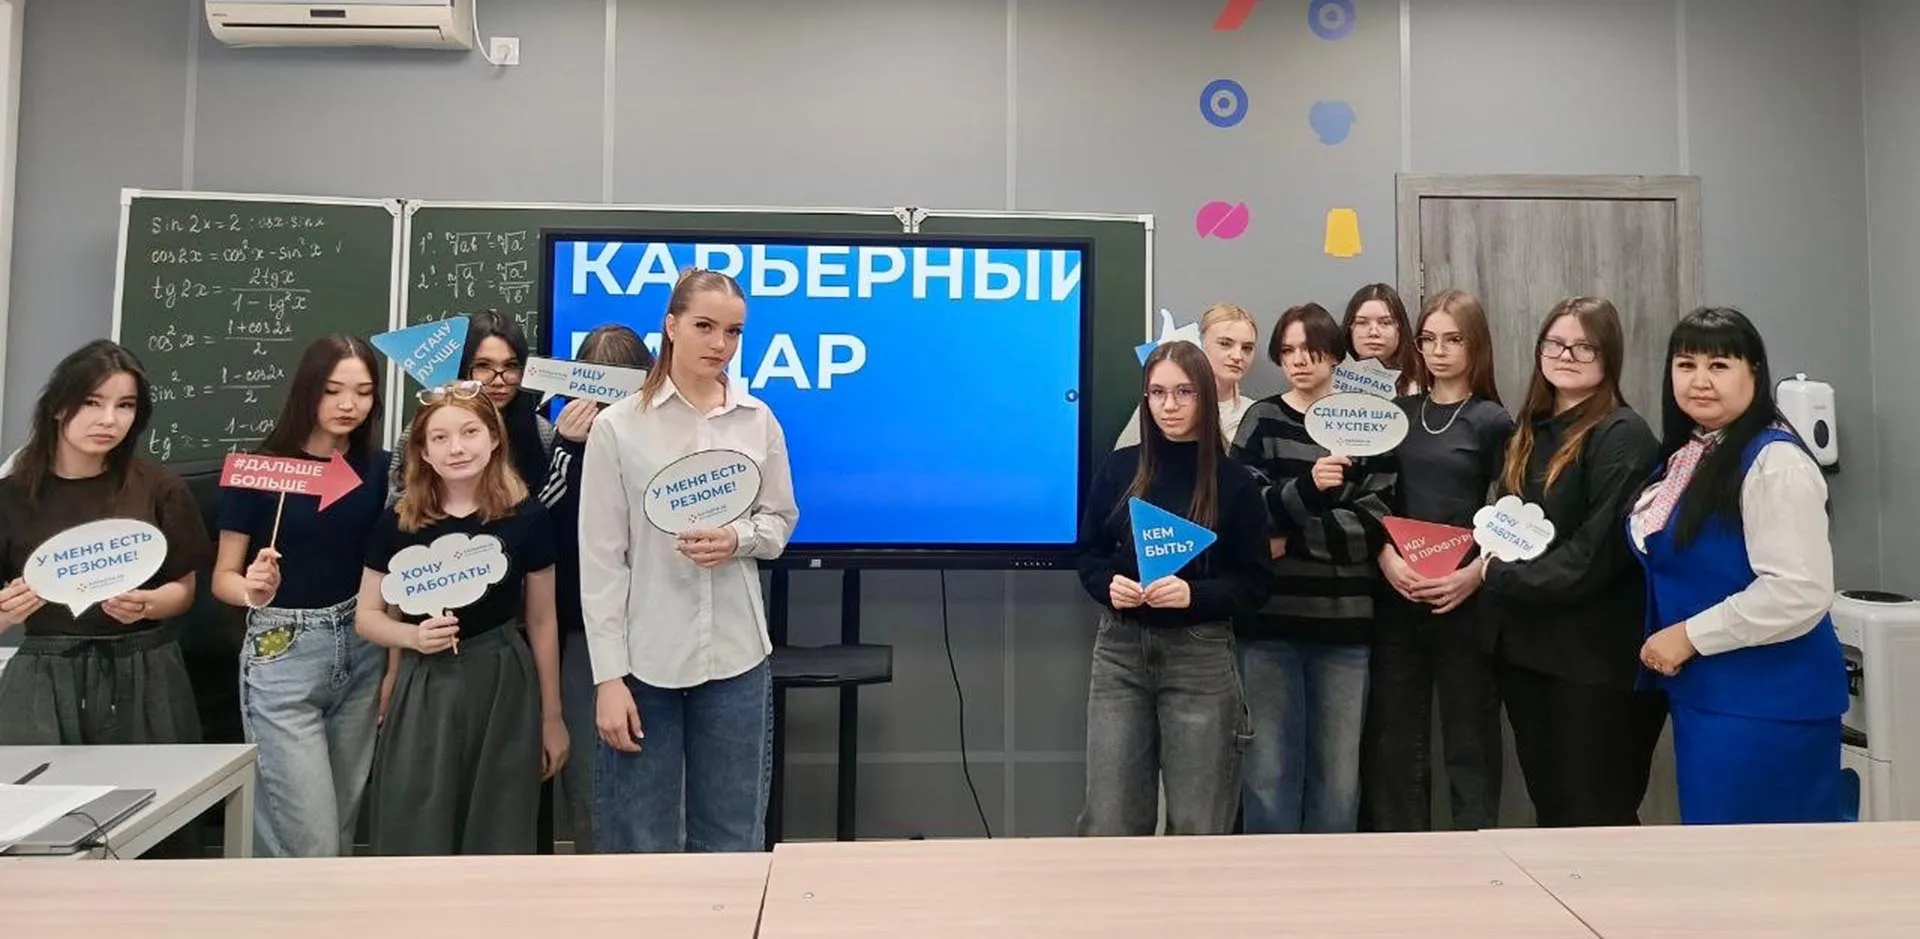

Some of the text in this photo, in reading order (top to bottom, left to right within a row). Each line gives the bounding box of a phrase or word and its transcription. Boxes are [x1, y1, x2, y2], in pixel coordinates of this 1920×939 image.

[403, 322, 452, 369] Я СТАНУ
[417, 339, 461, 380] ЛУЧШЕ
[571, 367, 606, 380] ИЩУ
[1333, 367, 1393, 393] ЫБИРАЮ
[569, 381, 628, 399] РАБОТУ!
[1313, 407, 1400, 420] СДЕЛАЙ ШАГ
[1325, 421, 1388, 432] К УСПЕХУ
[233, 457, 324, 477] #ДАЛЬШЕ
[229, 473, 308, 492] БОЛЬШЕ
[652, 463, 747, 499] У МЕНЯ ЕСТЬ
[670, 481, 737, 511] РЕЗЮМЕ!
[1495, 511, 1520, 528] ХОЧУ
[1142, 526, 1174, 541] КЕМ
[1486, 521, 1534, 553] РАБОТАТЬ!
[36, 532, 152, 567] У МЕНЯ ЕСТЬ
[1144, 540, 1195, 557] БЫТЬ?
[1403, 536, 1426, 552] ИДУ
[57, 550, 138, 579] РЕЗЮМЕ!
[1409, 552, 1419, 563] В
[401, 561, 443, 582] ХОЧУ
[405, 563, 492, 597] РАБОТАТЬ!
